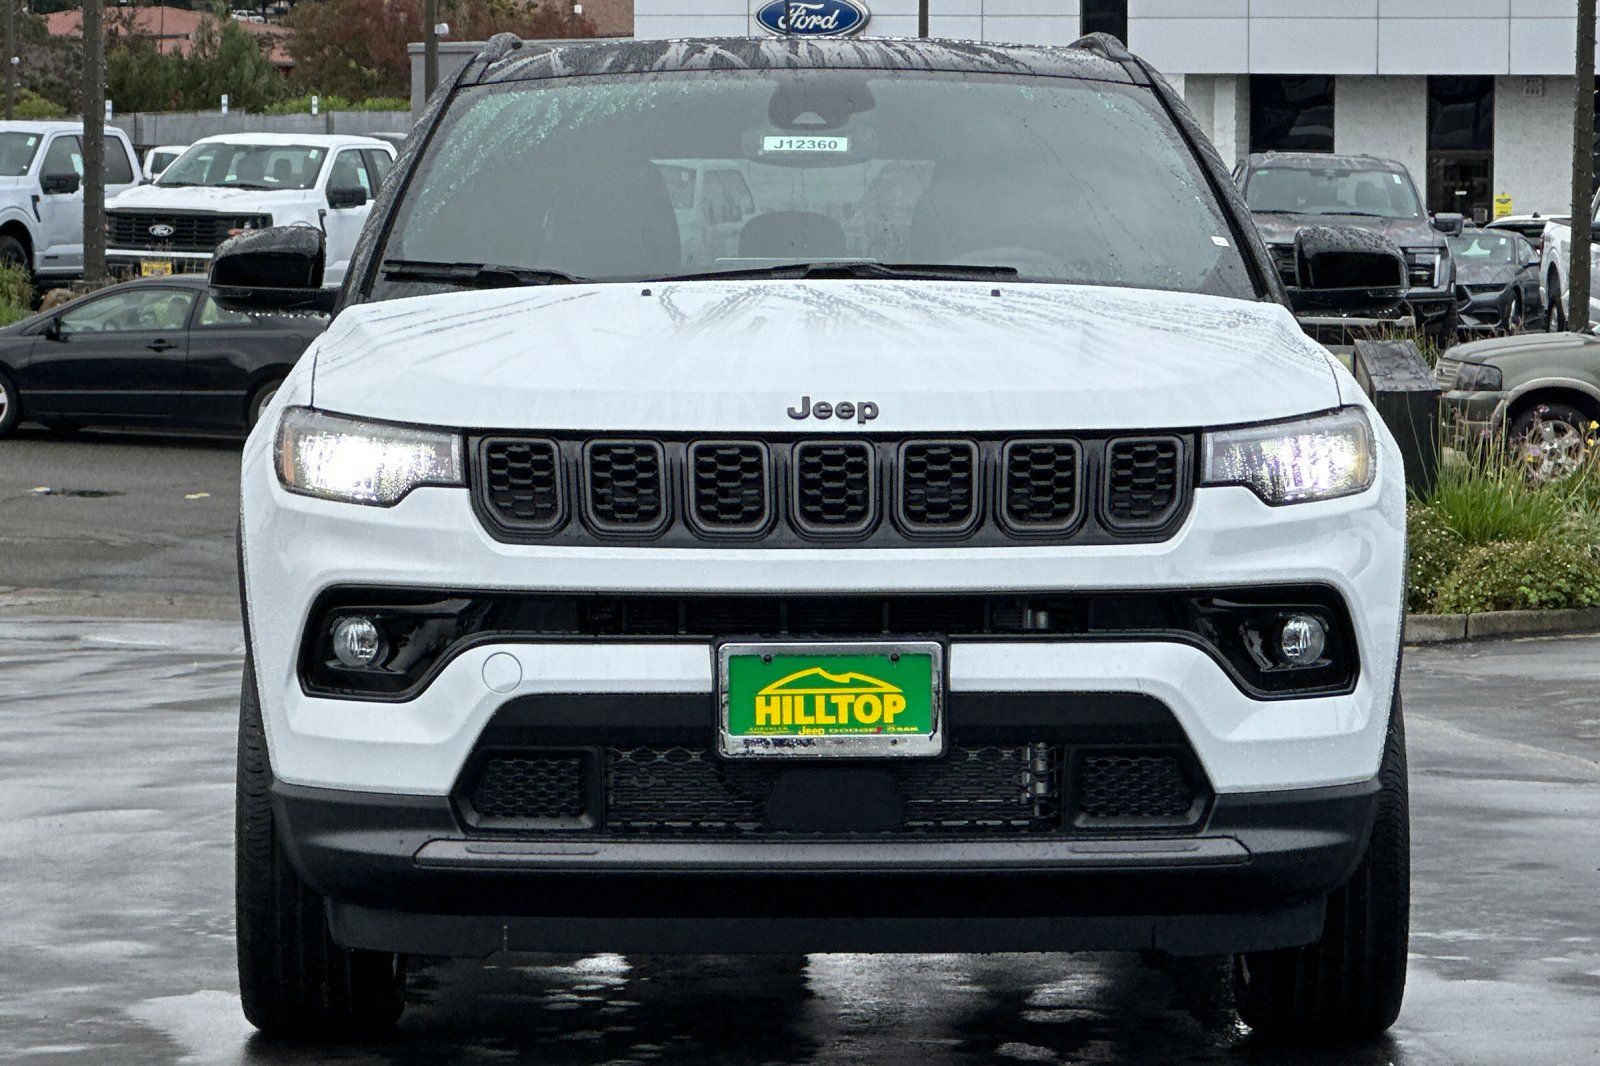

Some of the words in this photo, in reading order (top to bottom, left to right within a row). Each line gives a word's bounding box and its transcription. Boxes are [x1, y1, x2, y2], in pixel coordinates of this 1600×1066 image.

[778, 2, 840, 30] Ford
[774, 139, 838, 150] J12360
[787, 396, 879, 424] Jeep
[755, 694, 907, 725] HILLTOP
[798, 726, 825, 735] Jeep
